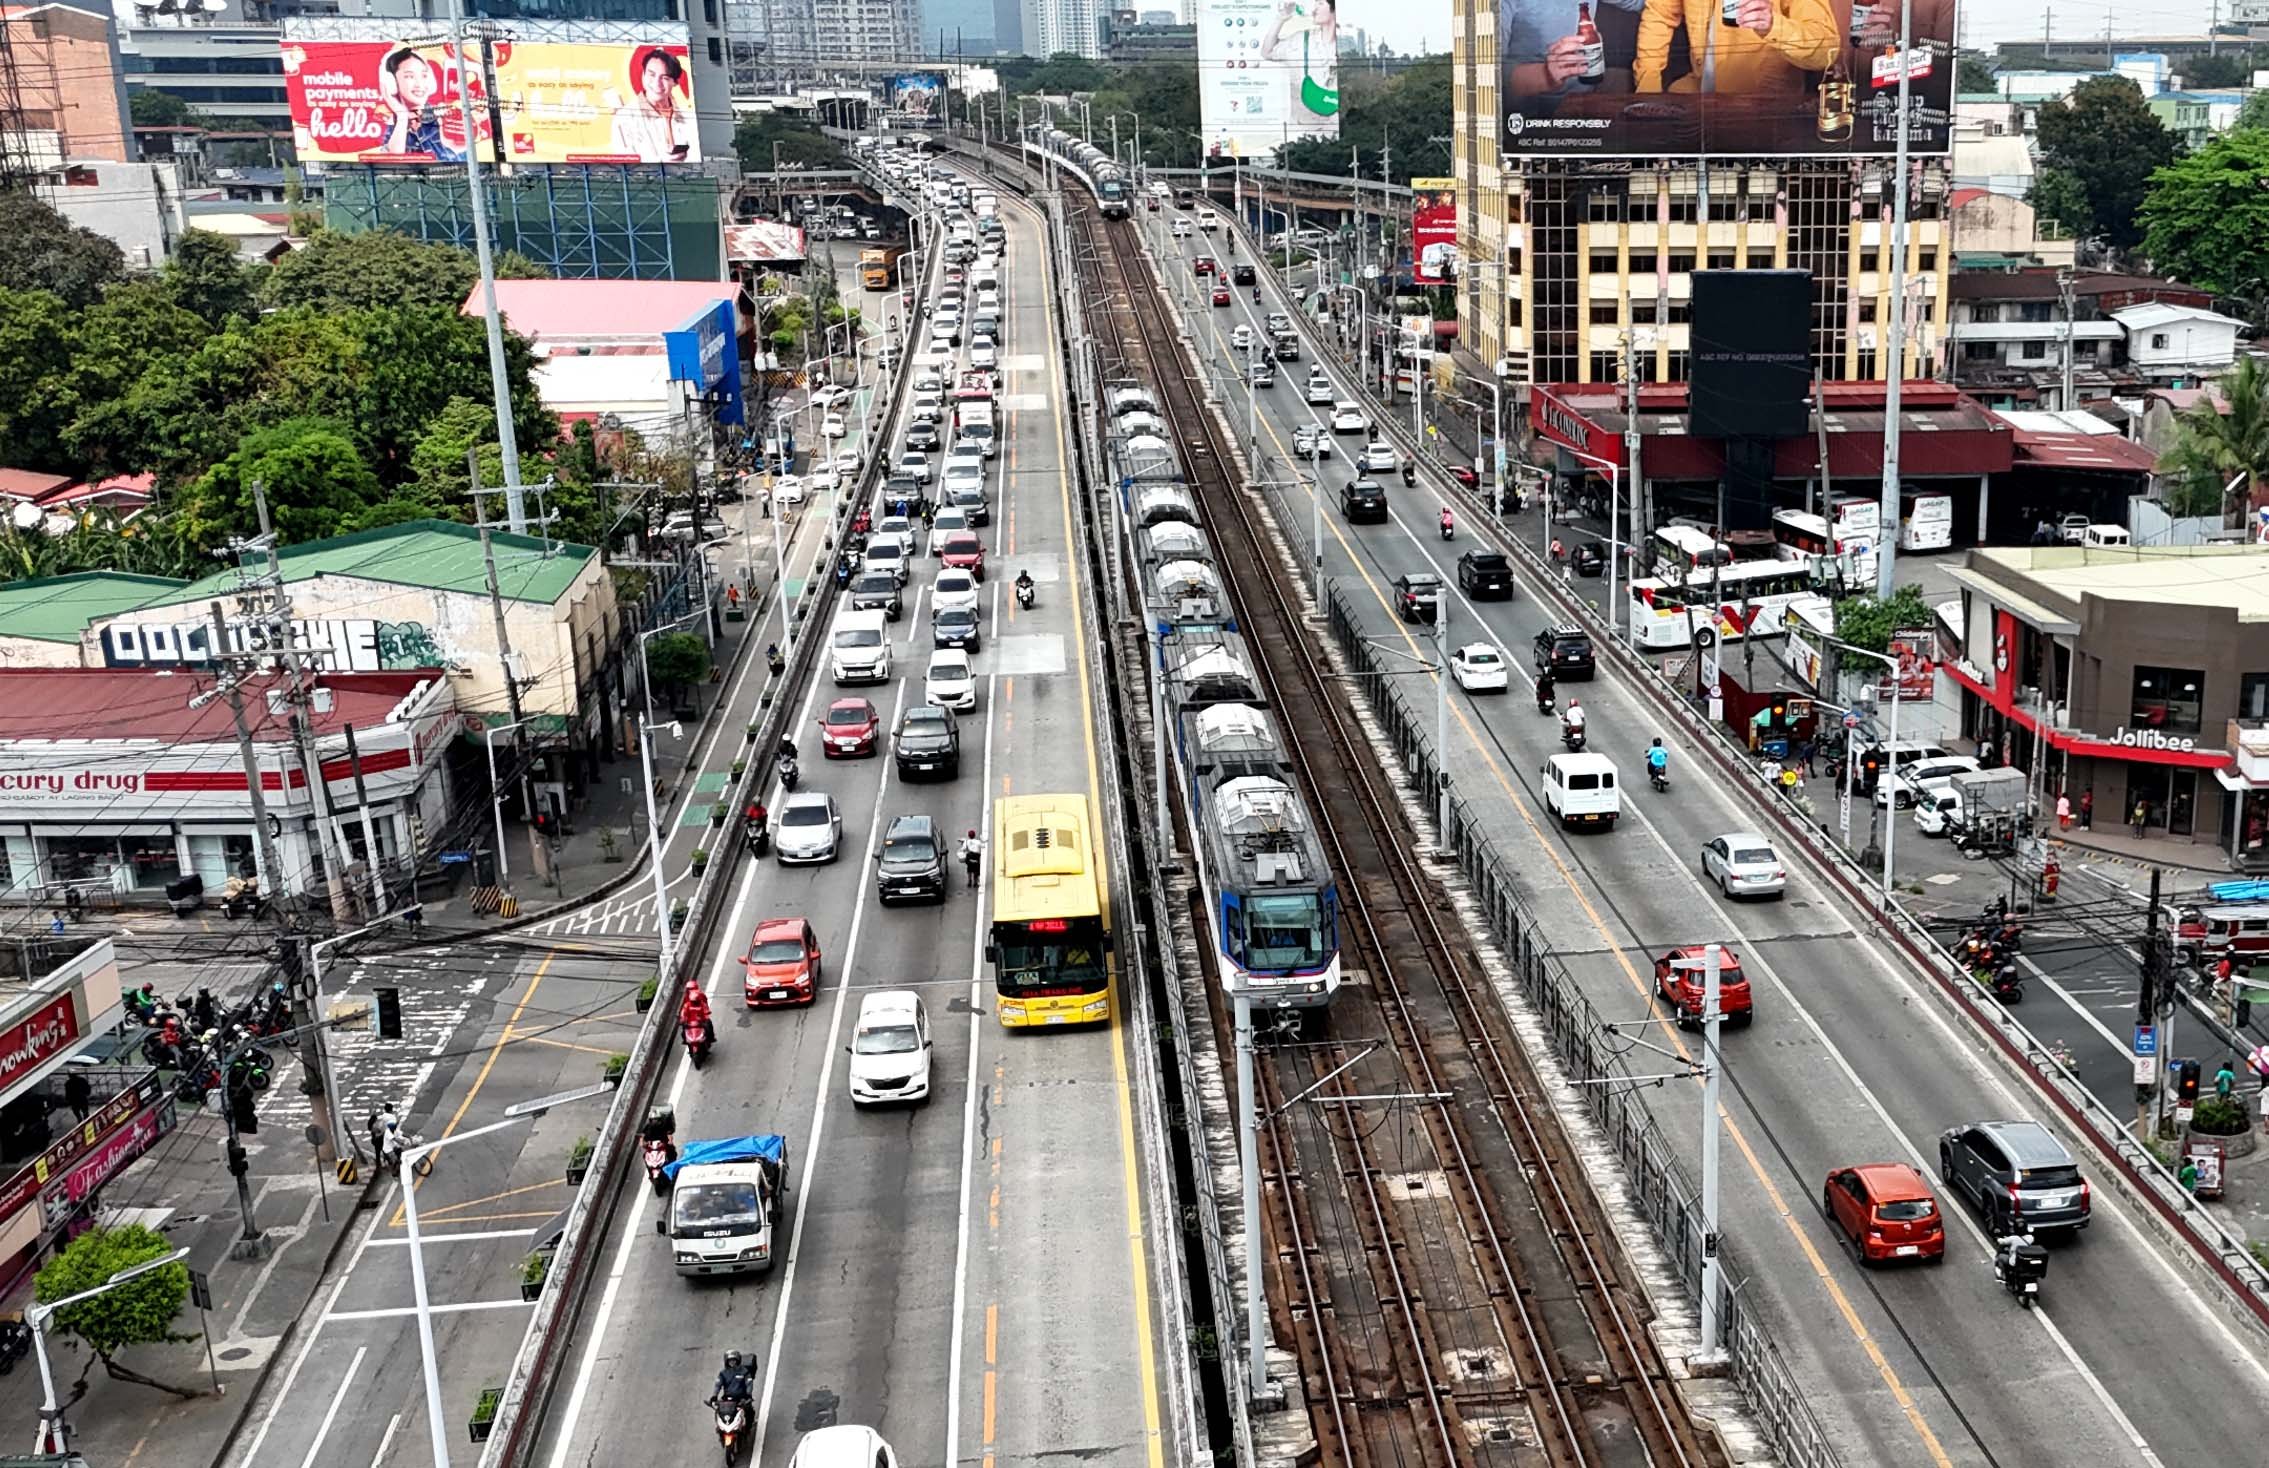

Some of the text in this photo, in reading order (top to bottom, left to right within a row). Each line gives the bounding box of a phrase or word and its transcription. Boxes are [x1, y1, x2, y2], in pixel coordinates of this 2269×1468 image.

[303, 71, 353, 86] mobile
[310, 108, 382, 138] hello
[1525, 119, 1611, 128] DRINK RESPONSIBLY
[2109, 727, 2194, 752] Jollibee
[74, 770, 138, 793] drug
[704, 1229, 731, 1237] ISUZU
